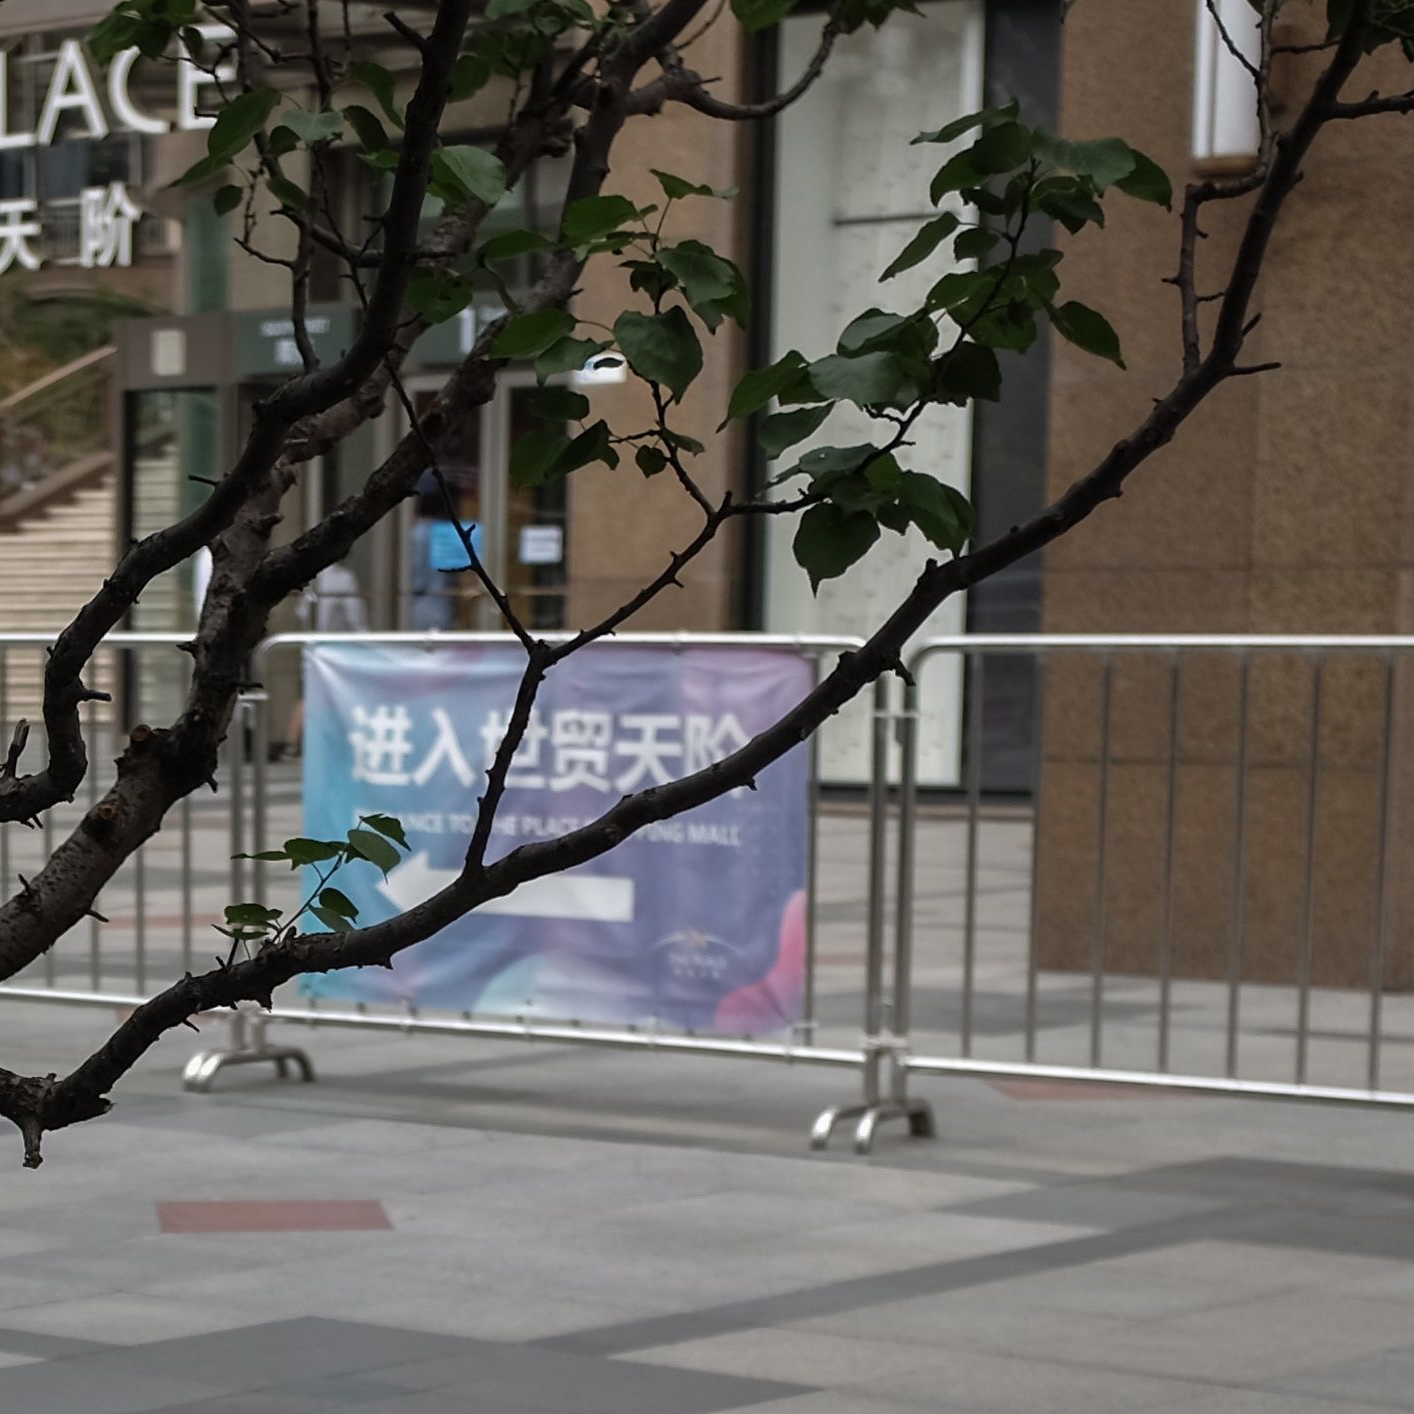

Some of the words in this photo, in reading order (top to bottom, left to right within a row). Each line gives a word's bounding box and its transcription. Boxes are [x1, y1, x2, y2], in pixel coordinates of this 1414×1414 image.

[348, 704, 750, 797] 进入世贸天阶
